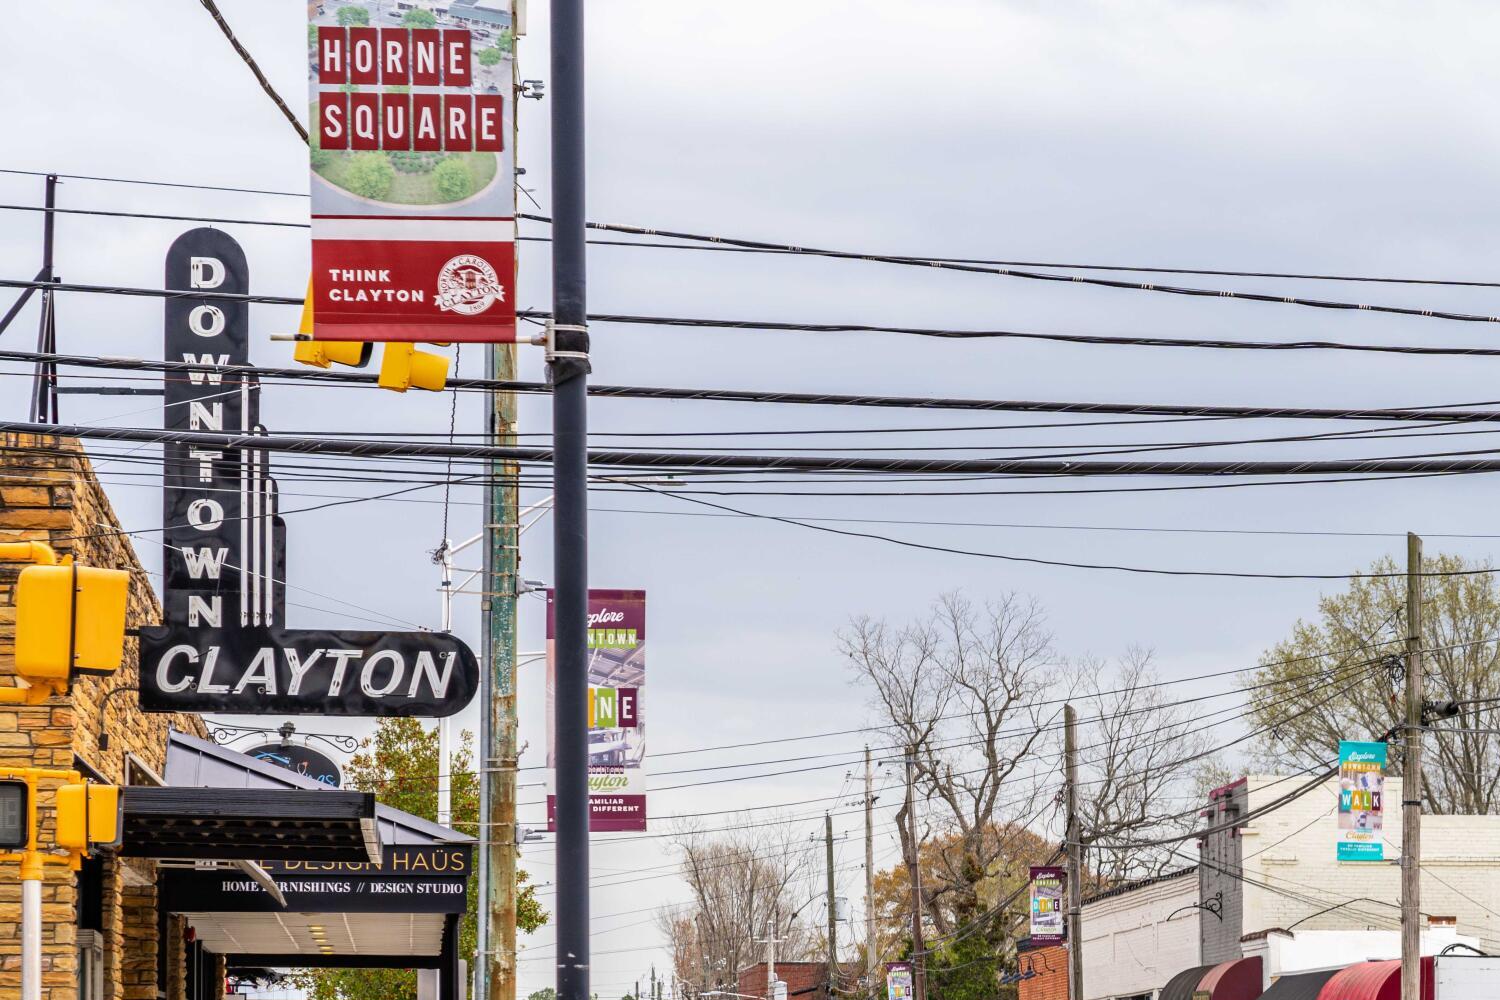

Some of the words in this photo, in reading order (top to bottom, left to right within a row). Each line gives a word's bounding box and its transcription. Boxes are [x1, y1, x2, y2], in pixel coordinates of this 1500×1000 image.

[323, 39, 464, 75] HORNE
[324, 104, 497, 140] SQUARE
[328, 268, 391, 282] THINK
[458, 257, 495, 285] CAROLINA
[328, 288, 424, 302] CLAYTON
[442, 285, 499, 308] CLAYTON
[182, 256, 229, 628] DOWNTOWN
[588, 633, 636, 645] NTOWN
[155, 643, 457, 699] CLAYTON
[1348, 751, 1376, 762] Explore
[1342, 793, 1380, 807] WALK
[393, 850, 465, 871] HAÜS
[222, 880, 259, 892] HOME
[370, 882, 414, 894] DESIGN
[416, 882, 463, 894] STUDIO
